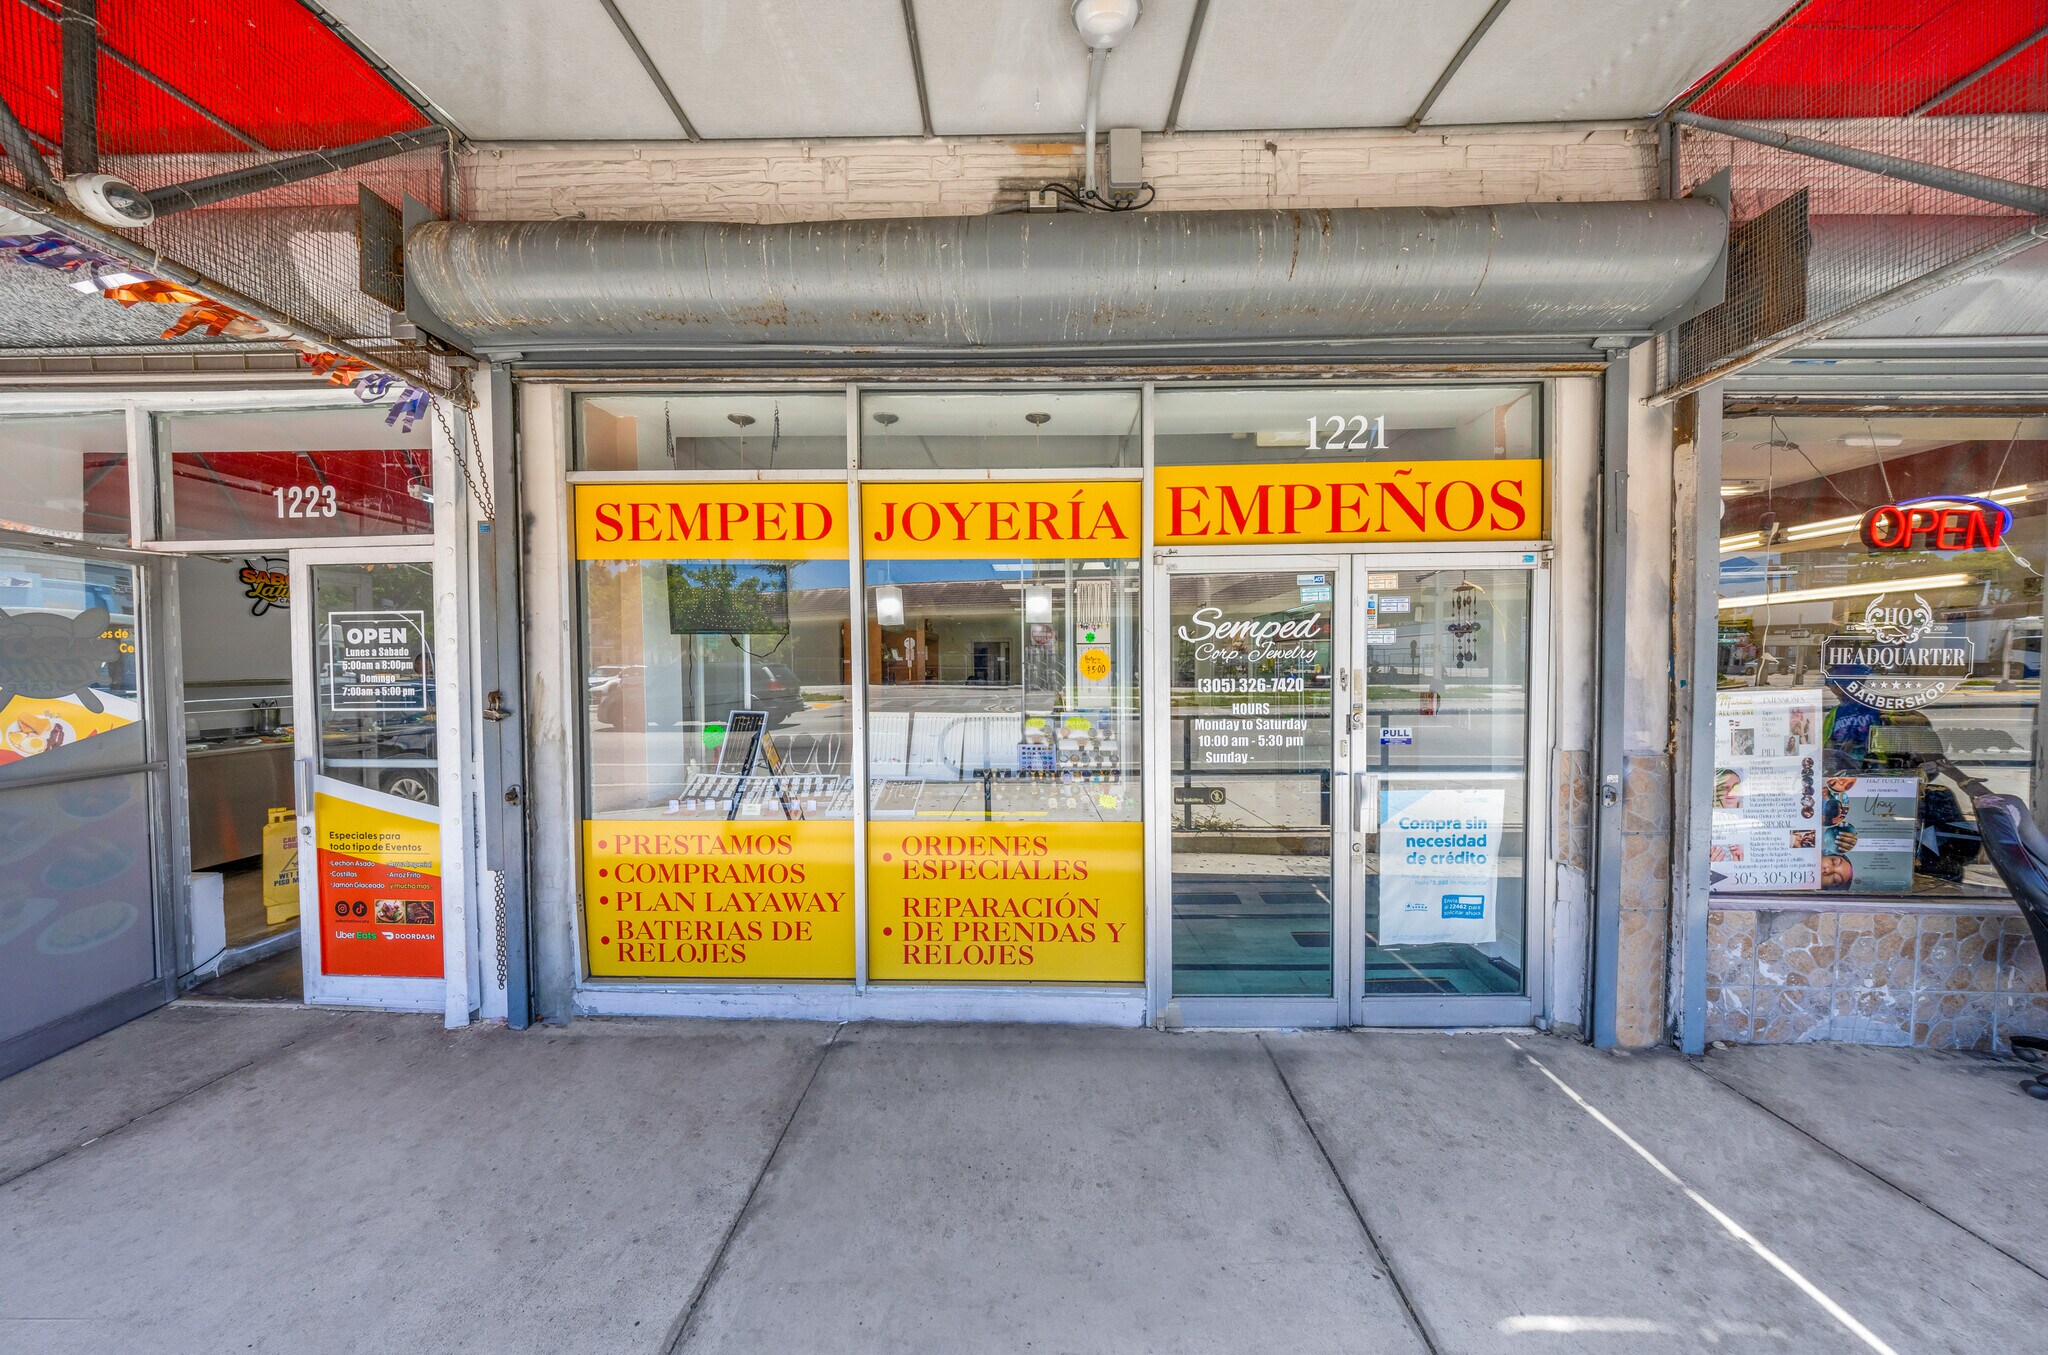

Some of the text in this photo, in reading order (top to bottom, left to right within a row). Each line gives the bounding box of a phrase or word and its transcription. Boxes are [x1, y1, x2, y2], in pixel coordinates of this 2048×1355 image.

[1305, 414, 1389, 450] 1221
[273, 485, 337, 519] 1223
[1166, 468, 1526, 536] EMPEÑOS
[595, 502, 833, 543] SEMPED
[874, 489, 1129, 542] JOYERÍA
[1868, 505, 2005, 551] OPEN
[1178, 607, 1321, 647] Semped
[1884, 607, 1913, 630] HQ
[114, 628, 129, 639] de
[346, 627, 407, 645] OPEN
[345, 648, 370, 657] Lunes
[1194, 640, 1319, 664] Corp. Jewelry
[1828, 647, 1966, 669] HEADQUARTER
[342, 660, 414, 671] 5:00am a 8:00pm
[360, 673, 396, 684] Domingo
[1198, 677, 1305, 693] (305) 326-7420
[341, 687, 374, 696] 7:00am
[402, 688, 415, 698] pm
[1846, 681, 1945, 710] BARBERSHOP
[1232, 702, 1270, 715] HOURS
[1194, 717, 1308, 734] Monday to Saturday
[1382, 729, 1410, 737] PULL
[1198, 734, 1228, 747] 10:00
[1231, 738, 1248, 747] am
[1258, 733, 1283, 747] 5:30
[1285, 737, 1304, 749] pm
[1205, 751, 1248, 766] Sunday
[1399, 816, 1488, 832] Compra sin
[283, 836, 298, 844] CAU
[329, 831, 401, 841] Especiales para
[614, 834, 793, 856] PRESTAMOS
[902, 835, 1049, 857] ORDENES
[1405, 834, 1488, 848] necesidad
[330, 843, 422, 852] todo tipo de Eventos
[1406, 850, 1487, 865] de crédito
[614, 863, 806, 884] COMPRAMOS
[902, 859, 1089, 881] ESPECIALES
[1730, 870, 1816, 886] 305.305.1913
[615, 892, 847, 913] PLAN LAYAWAY
[902, 892, 1100, 919] REPARACIÓN
[335, 931, 377, 939] Uber Eats
[616, 920, 813, 941] BATERIAS DE
[902, 921, 1127, 943] DE PRENDAS Y
[617, 943, 747, 965] RELOJES
[902, 944, 1035, 966] RELOJES
